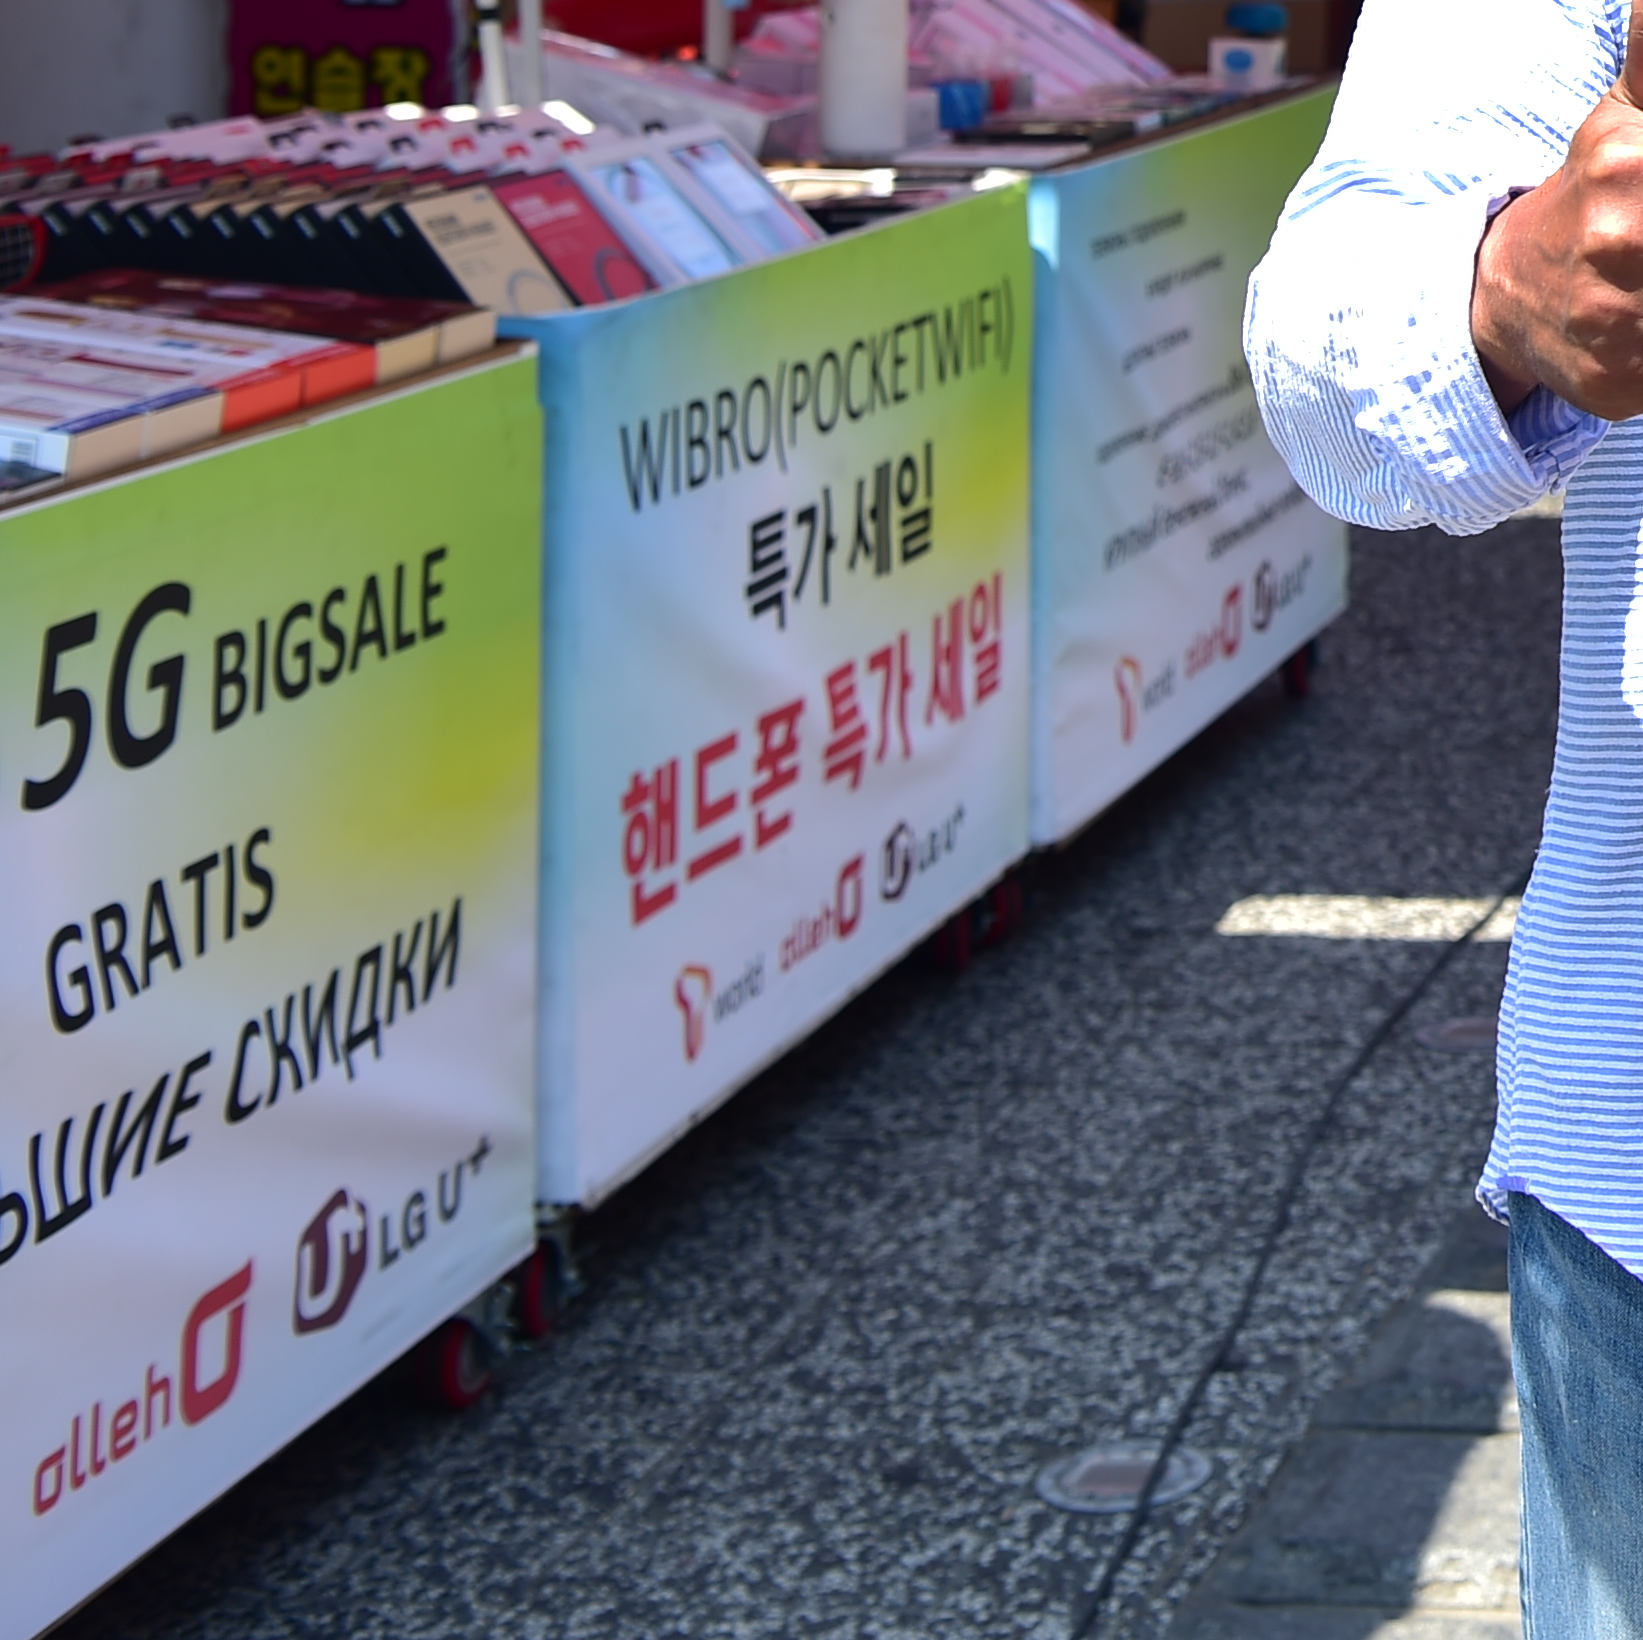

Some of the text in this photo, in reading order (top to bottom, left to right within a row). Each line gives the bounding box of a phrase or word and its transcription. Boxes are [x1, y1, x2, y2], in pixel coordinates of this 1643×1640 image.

[252, 45, 430, 114] 연습장
[746, 441, 933, 630] 특가 세일
[21, 545, 449, 811] 5G BIGSALE
[621, 569, 1003, 927] 핸드폰 특가 세일
[45, 825, 277, 1035] GRATIS
[224, 895, 463, 1124] СКИДКИ
